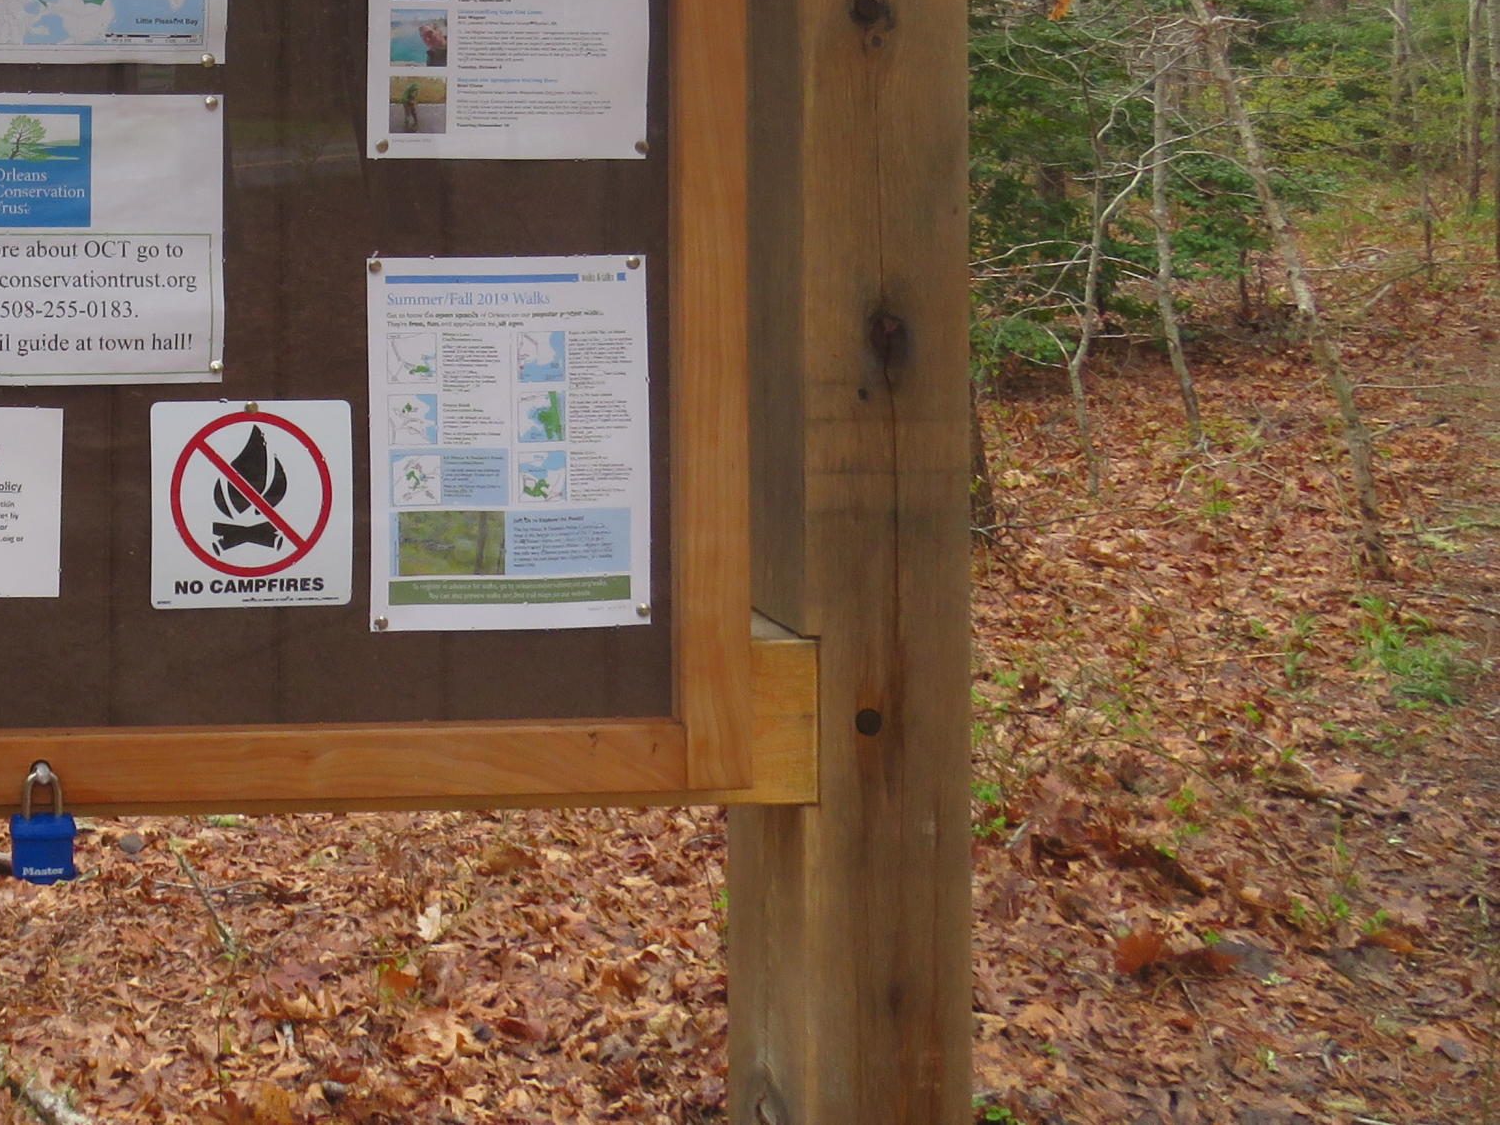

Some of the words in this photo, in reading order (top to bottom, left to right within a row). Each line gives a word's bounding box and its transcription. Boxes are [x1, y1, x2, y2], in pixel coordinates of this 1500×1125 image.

[26, 240, 77, 258] about
[84, 240, 131, 258] OCT
[137, 245, 160, 263] go
[166, 242, 184, 259] to
[387, 291, 472, 306] Summer/Fall
[477, 291, 508, 306] 2019
[513, 291, 550, 306] Walks
[0, 300, 138, 319] 508-255-0183.
[17, 334, 69, 356] guide
[76, 336, 92, 351] at
[99, 336, 145, 351] town
[151, 334, 192, 351] hall!
[174, 579, 203, 595] NO
[209, 577, 324, 594] CAMPFIRES
[22, 866, 64, 876] Master
